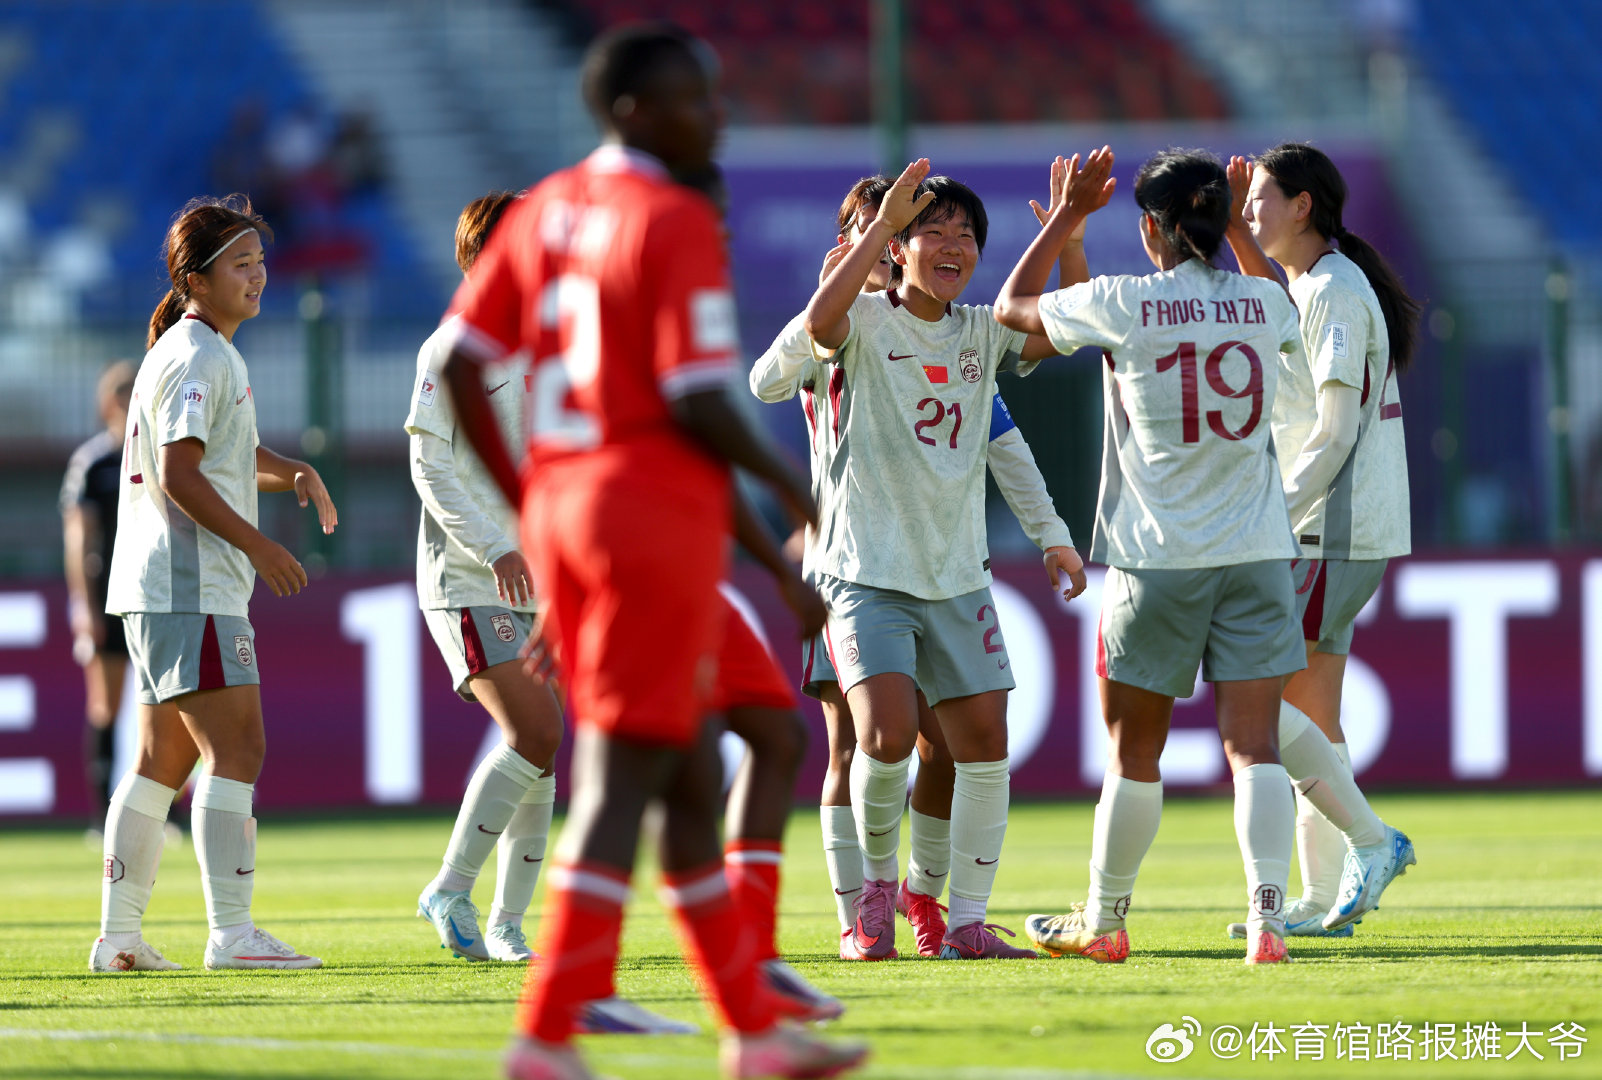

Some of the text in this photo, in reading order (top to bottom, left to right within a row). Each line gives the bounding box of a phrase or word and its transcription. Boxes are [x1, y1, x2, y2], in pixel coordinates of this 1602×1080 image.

[1141, 298, 1205, 327] FANG
[534, 270, 603, 447] 2
[1155, 340, 1263, 443] 19
[914, 397, 963, 449] 21
[1261, 888, 1276, 911] 中国
